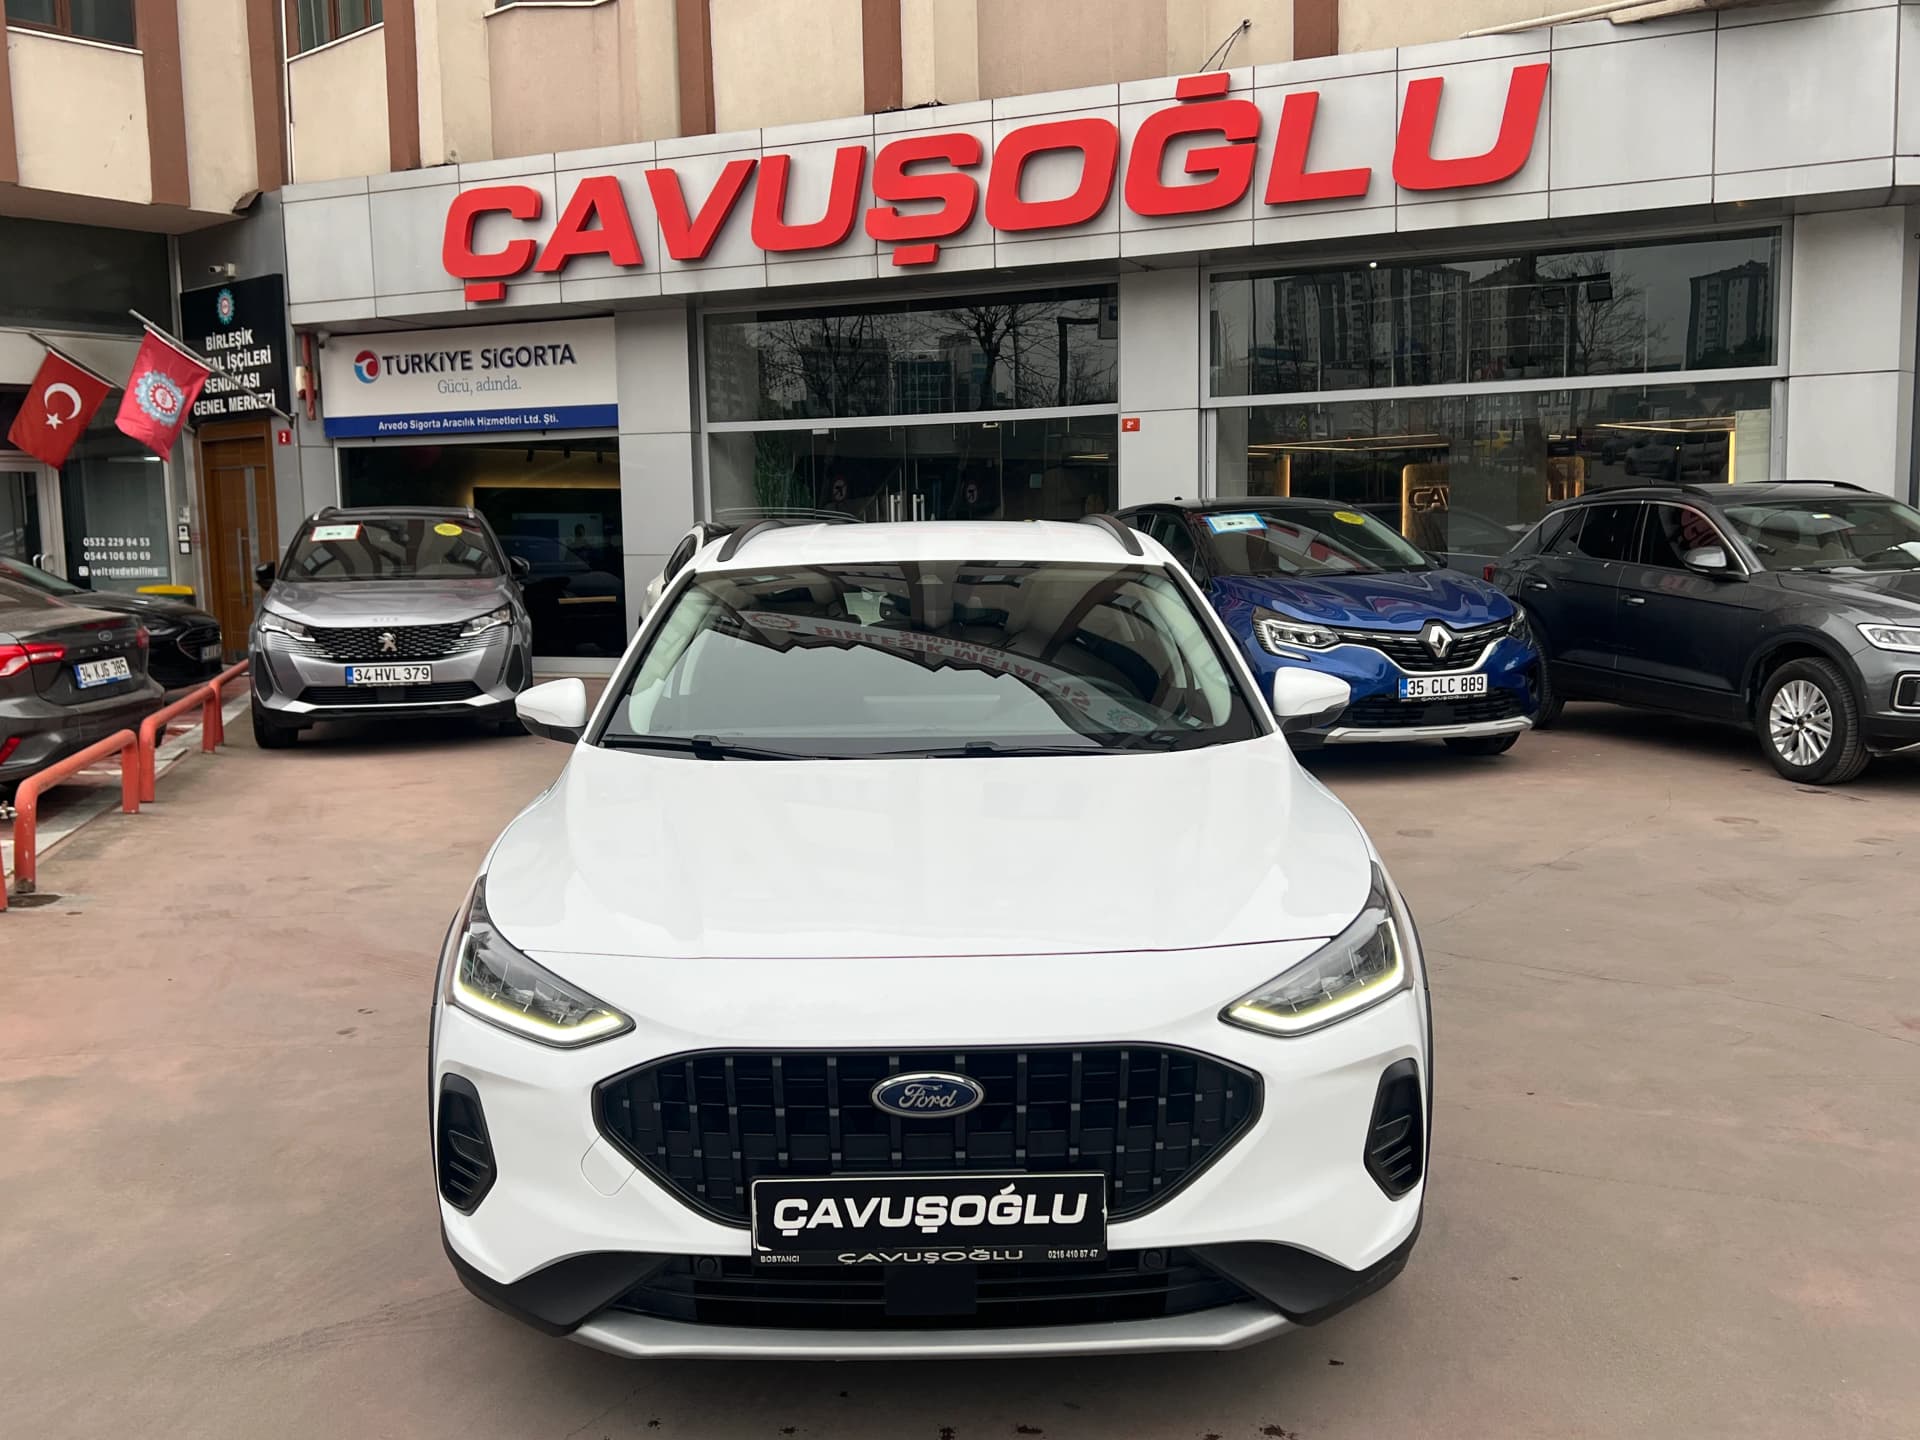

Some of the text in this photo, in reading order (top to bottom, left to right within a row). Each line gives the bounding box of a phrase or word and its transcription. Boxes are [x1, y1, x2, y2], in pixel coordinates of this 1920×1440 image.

[442, 63, 1550, 302] ÇAVUŞOĞLU
[205, 327, 254, 350] BİRLEŞİK
[226, 345, 272, 372] İŞÇİLERİ
[382, 343, 577, 376] TÜRKİYE SİGORTA
[437, 375, 522, 396] Gücü, adında.
[193, 398, 227, 416] GENEL
[409, 419, 440, 432] Sigorta
[442, 416, 475, 429] Aracılık
[477, 415, 522, 428] Hizmetleri
[523, 414, 542, 426] Ltd.
[543, 412, 560, 425] Şti.
[83, 537, 106, 547] 0532
[83, 551, 107, 561] 0544
[354, 668, 371, 682] 34
[374, 668, 402, 681] HVL
[403, 667, 430, 680] 379
[1408, 679, 1424, 695] 35
[1431, 678, 1455, 694] CLC
[1460, 676, 1484, 692] 889
[898, 1083, 957, 1109] Ford
[773, 1183, 1088, 1236] ÇAVUŞOĞLU
[760, 1254, 800, 1263] BOSTANCI
[837, 1248, 1024, 1265] ÇAVUŞOĞLU
